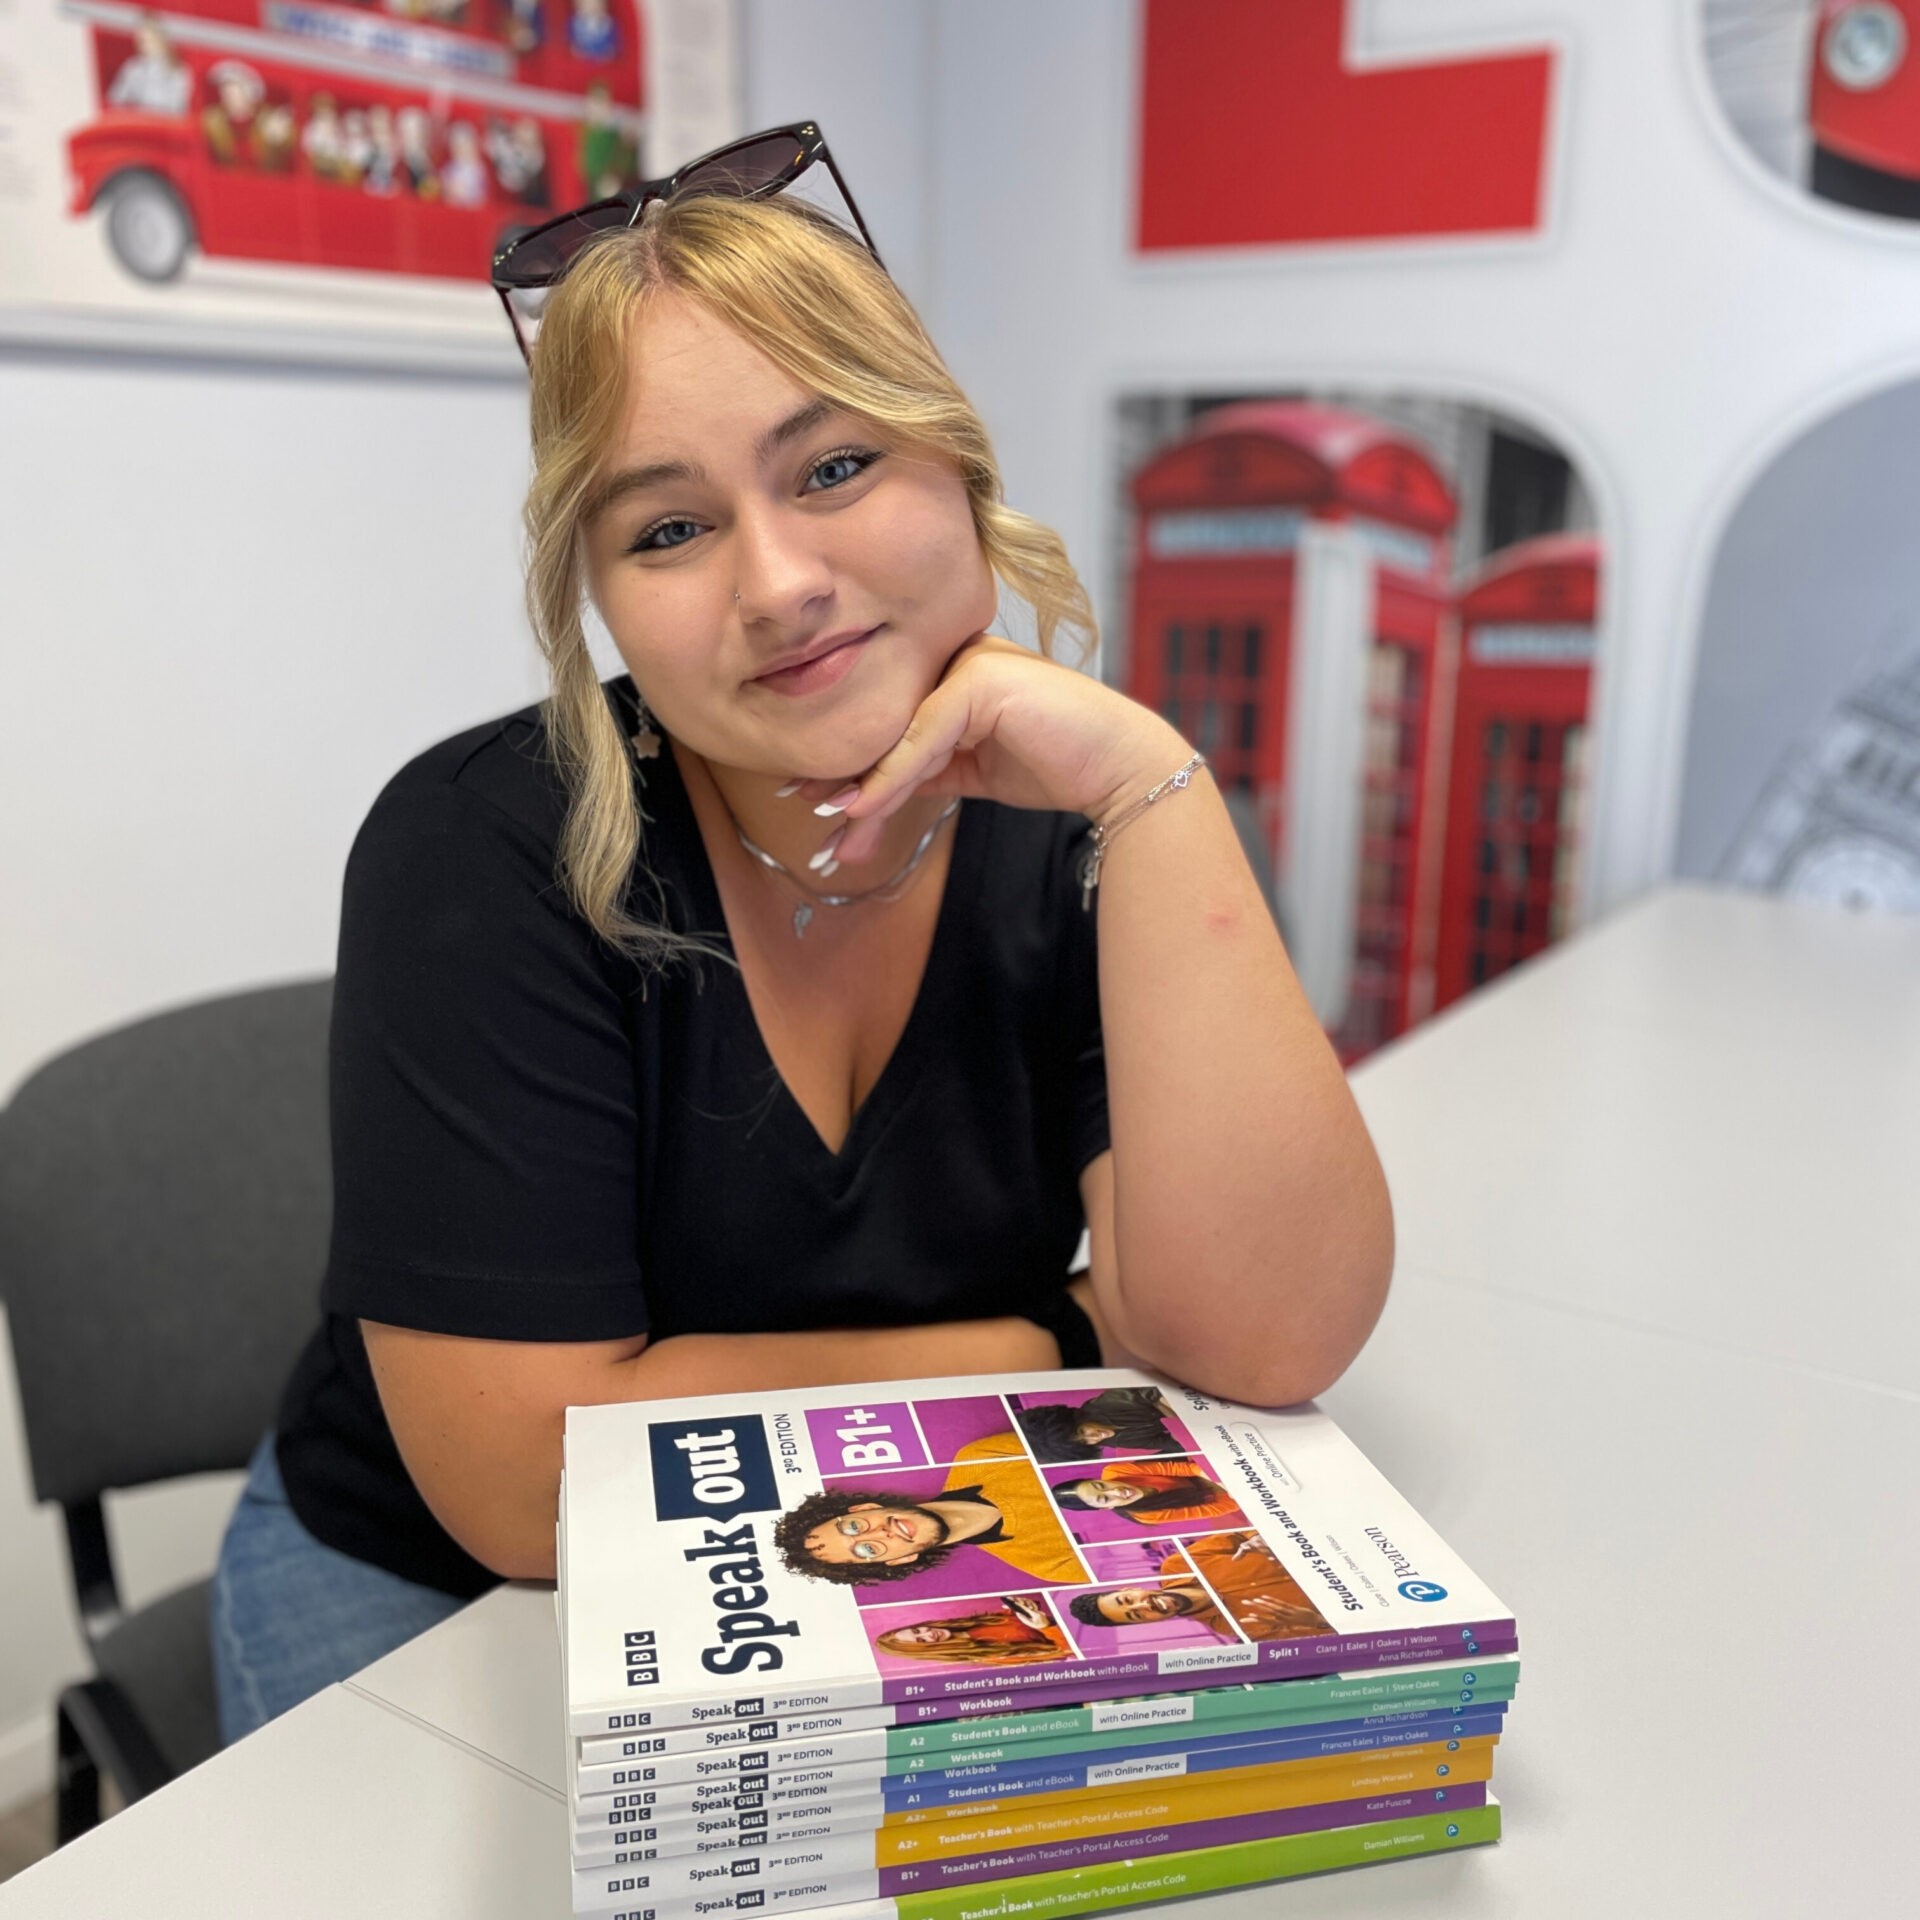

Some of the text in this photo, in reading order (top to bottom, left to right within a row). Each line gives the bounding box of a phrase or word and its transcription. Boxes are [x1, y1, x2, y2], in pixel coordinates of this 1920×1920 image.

[835, 1408, 902, 1467] B1+
[1214, 1424, 1234, 1444] eBook
[774, 1413, 802, 1475] 3RD EDITION
[1228, 1443, 1243, 1458] with
[1245, 1432, 1283, 1479] Online Practice
[1233, 1458, 1281, 1510] Workbook
[1274, 1508, 1297, 1530] and
[1287, 1531, 1320, 1559] Book
[1365, 1527, 1420, 1578] Pearson
[1311, 1557, 1364, 1612] Student's
[1316, 1635, 1437, 1654] Clare Eales Oakes Wilson
[624, 1630, 660, 1687] BBC
[1165, 1652, 1252, 1669] with Online Practice
[1269, 1648, 1300, 1659] Split 1
[1379, 1648, 1444, 1662] Anna Richardson
[945, 1663, 1150, 1691] Student's Book and Workbook with eBook
[905, 1686, 925, 1696] B1+
[1330, 1680, 1440, 1698] Frances Eales Steve Oakes
[789, 1695, 828, 1707] EDITION
[960, 1696, 1012, 1711] Workbook
[918, 1706, 938, 1716] B1+
[1100, 1707, 1186, 1724] with Online Practice
[609, 1713, 651, 1728] BBC
[803, 1718, 842, 1730] EDITION
[952, 1719, 1080, 1742] Student's Book and eBook
[623, 1739, 665, 1755] BBC
[910, 1738, 925, 1746] A2
[1321, 1730, 1428, 1750] Frances Eales Steve Oakes
[794, 1748, 833, 1760] EDITION
[951, 1749, 1003, 1763] Workbook
[910, 1760, 924, 1768] A2
[944, 1764, 997, 1778] Workbook
[1094, 1761, 1180, 1779] with Online Practice
[613, 1768, 656, 1784] BBC
[794, 1771, 833, 1782] EDITION
[904, 1774, 916, 1784] A1
[788, 1786, 827, 1798] EDITION
[948, 1774, 1075, 1798] Student's Book and eBook
[614, 1792, 656, 1808] BBC
[907, 1794, 920, 1804] A1
[1366, 1798, 1412, 1810] Kate Fuscoe
[609, 1808, 651, 1824] BBC
[793, 1806, 832, 1818] EDITION
[792, 1826, 830, 1838] EDITION
[938, 1805, 1168, 1844] Teacher's Book with Teacher's Portal Access Code
[615, 1828, 657, 1844] BBC
[1364, 1834, 1424, 1850] Damian Williams
[898, 1840, 918, 1850] A2+
[941, 1832, 1169, 1874] Teacher's Book with Teacher's Portal Access Code
[615, 1849, 657, 1863] BBC
[784, 1854, 823, 1866] EDITION
[901, 1870, 920, 1880] B1+
[608, 1876, 650, 1893] BBC
[789, 1884, 827, 1897] EDITION
[1008, 1900, 1034, 1913] Book
[1035, 1897, 1056, 1908] with
[1056, 1889, 1100, 1904] Teacher's
[1101, 1884, 1129, 1896] Portal
[1131, 1879, 1162, 1890] Access
[1163, 1874, 1186, 1885] Code
